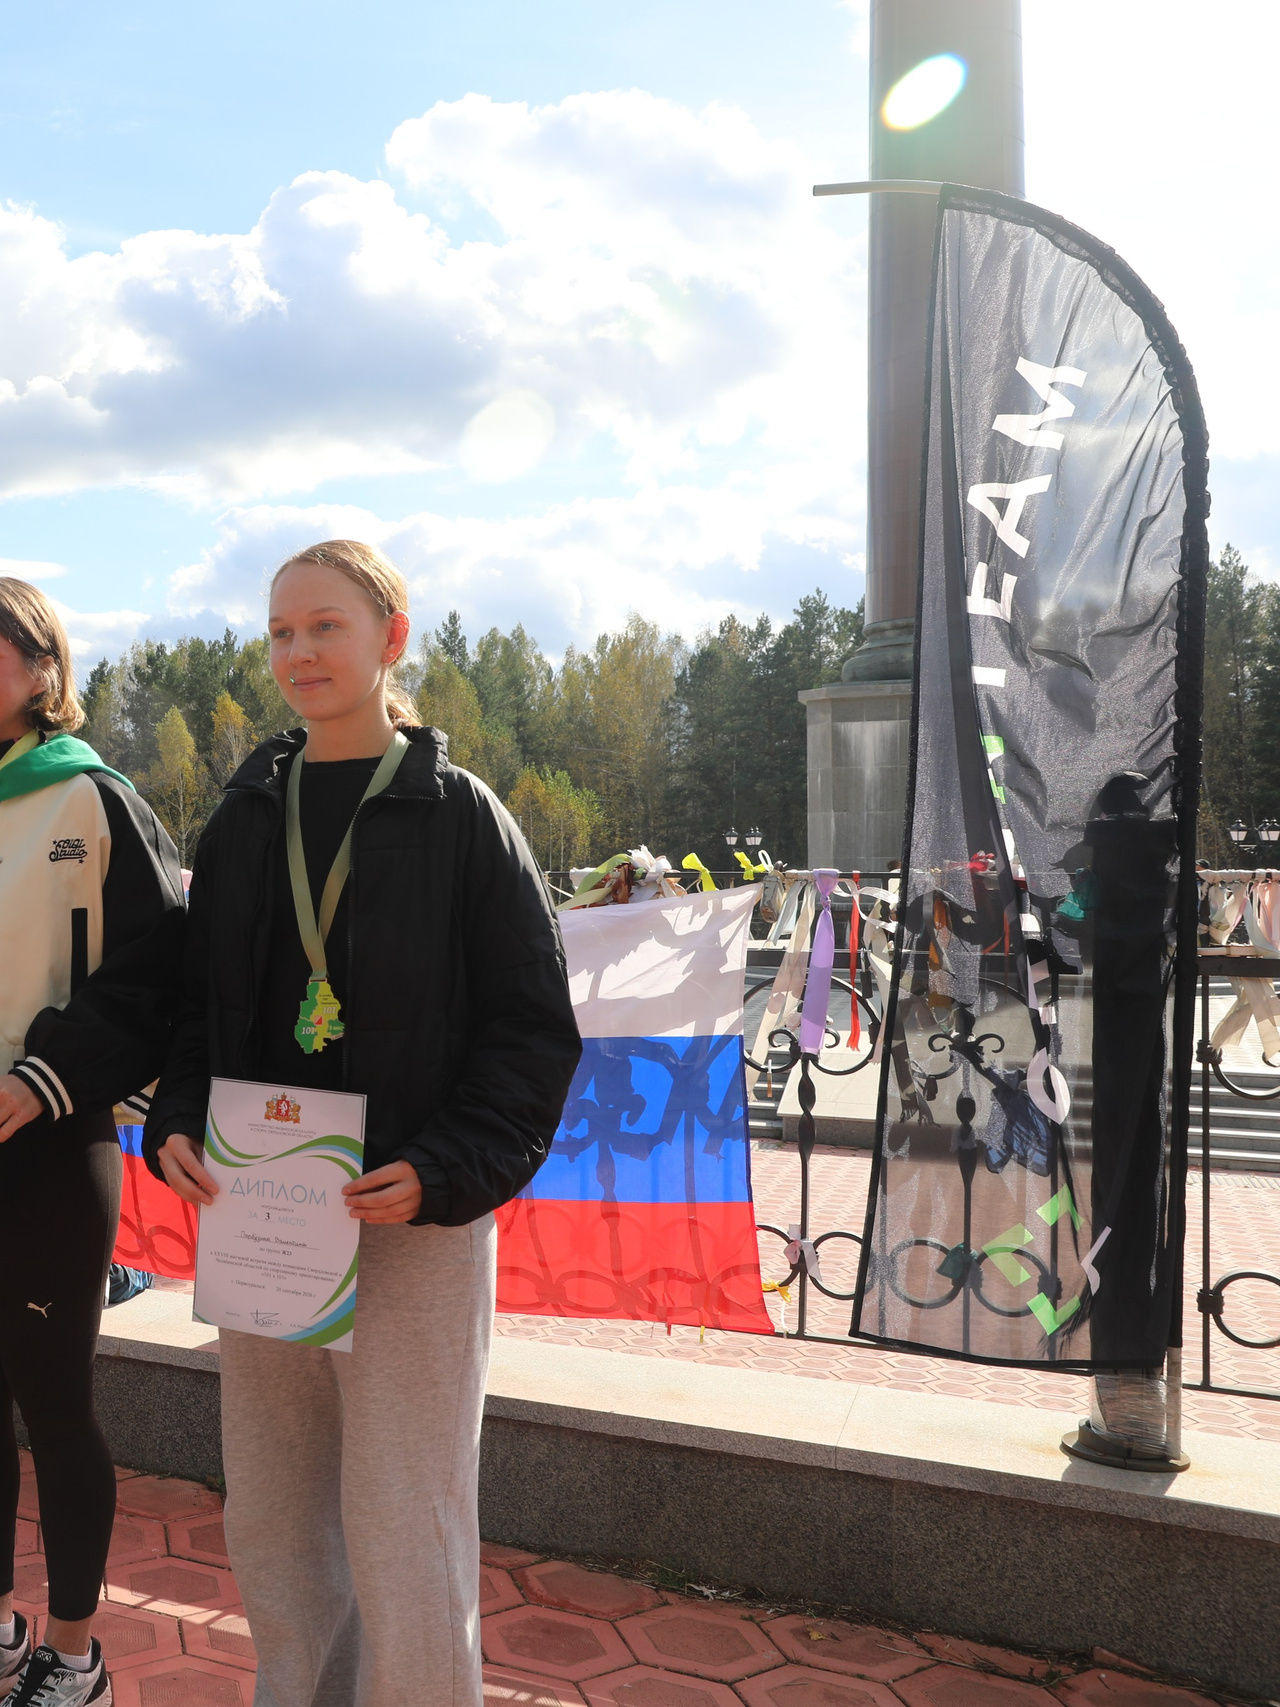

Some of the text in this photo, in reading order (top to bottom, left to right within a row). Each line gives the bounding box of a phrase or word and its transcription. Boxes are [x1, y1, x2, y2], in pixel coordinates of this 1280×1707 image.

[230, 1176, 328, 1207] ДИПЛОМ
[261, 1205, 294, 1213] награждается
[278, 1216, 307, 1227] МЕСТО
